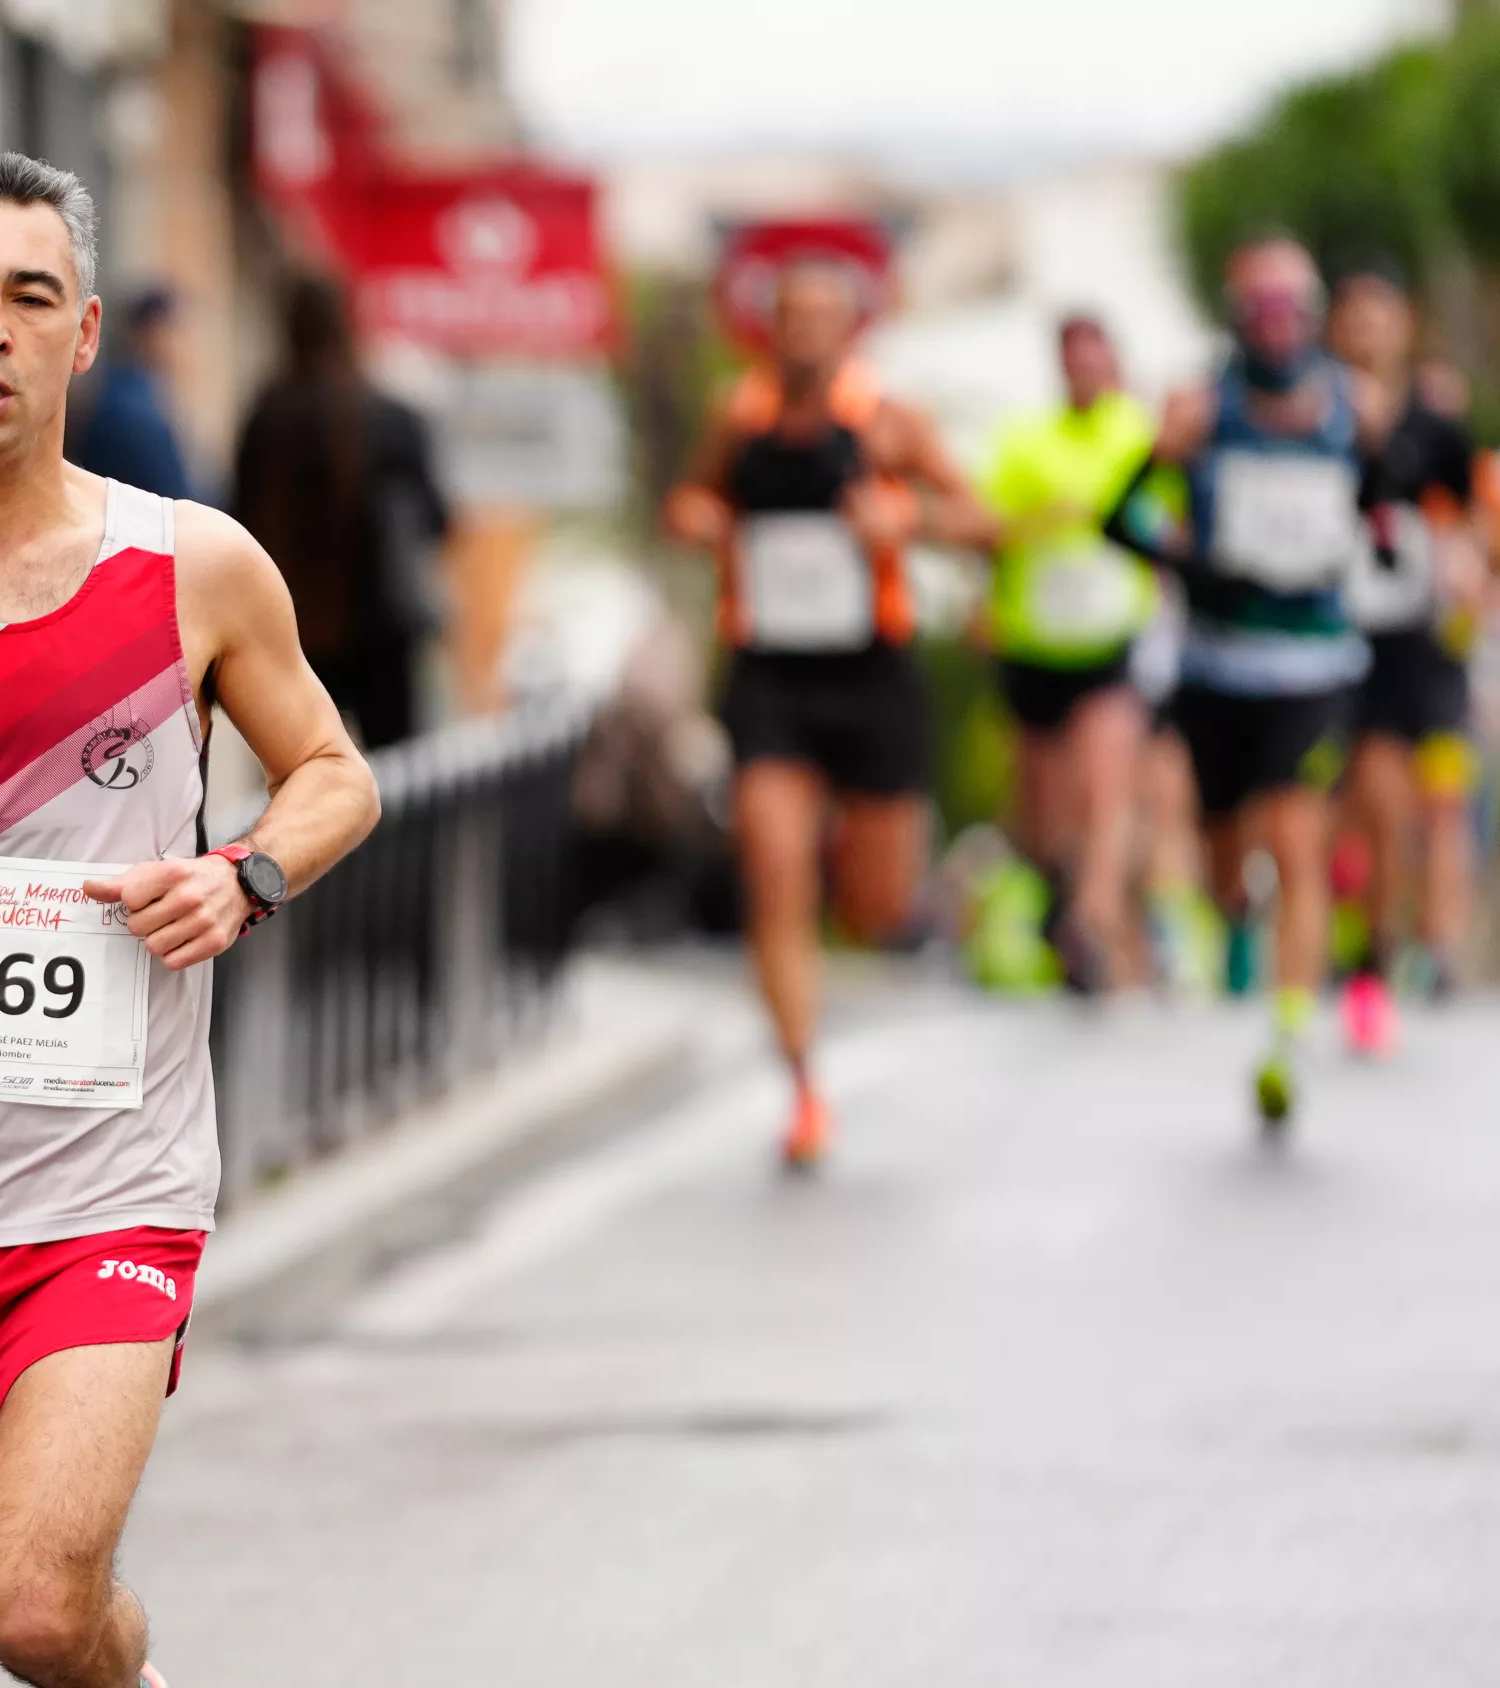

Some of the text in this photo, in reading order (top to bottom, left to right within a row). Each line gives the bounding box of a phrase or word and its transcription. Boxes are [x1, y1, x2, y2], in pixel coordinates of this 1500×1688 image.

[10, 1036, 33, 1046] PAEZ
[35, 1037, 69, 1049] MEJÍAS
[43, 1077, 130, 1088] mediamaratonlucena.com
